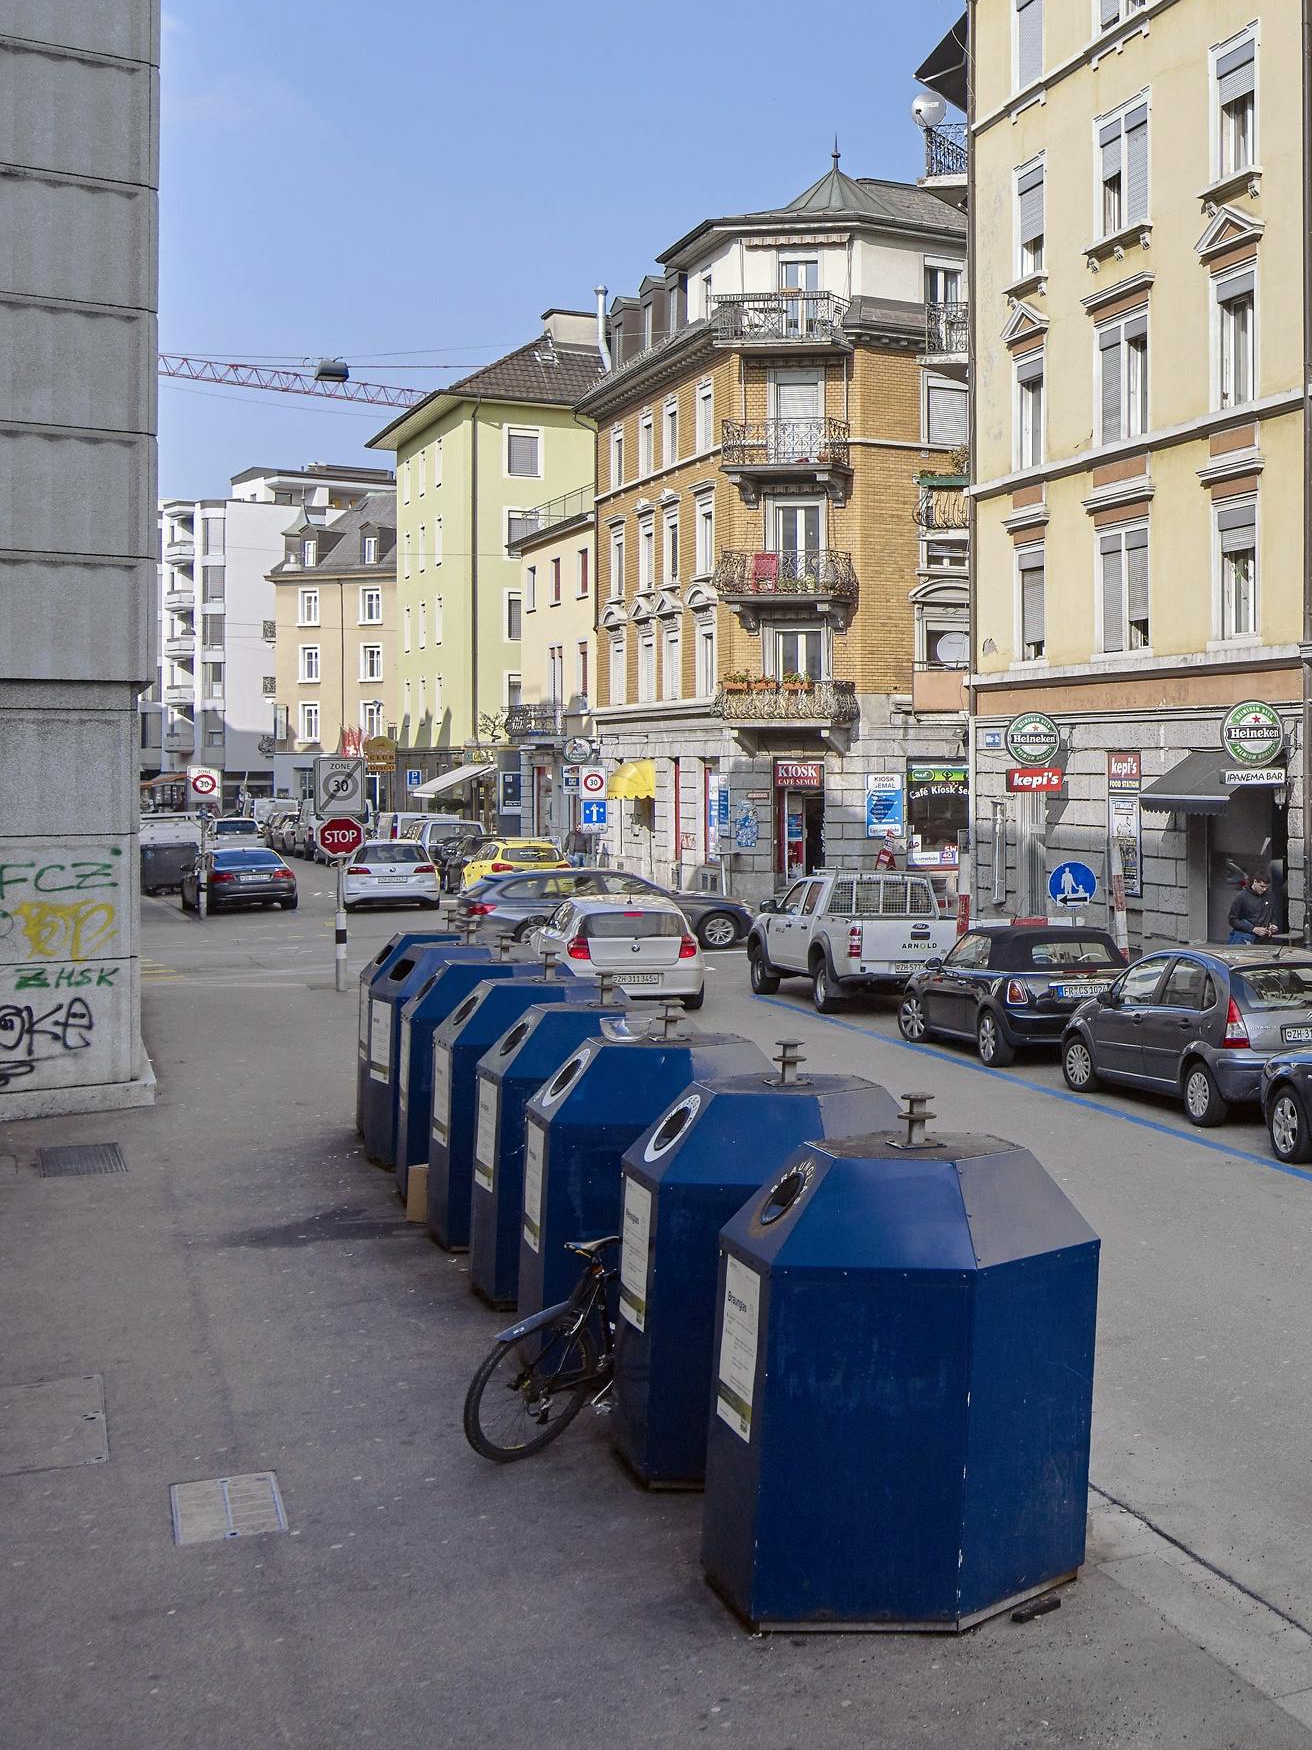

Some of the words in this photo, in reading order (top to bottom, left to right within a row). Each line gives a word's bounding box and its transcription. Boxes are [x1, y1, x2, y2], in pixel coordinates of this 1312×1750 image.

[1013, 734, 1056, 743] Heineken
[1230, 728, 1279, 739] Heineken
[778, 765, 817, 777] KIOSK
[1111, 757, 1137, 778] kepi's
[1013, 771, 1059, 789] kepi's
[1226, 772, 1265, 782] IPANEMA
[1266, 772, 1283, 781] BAR
[200, 780, 209, 788] 30
[333, 780, 348, 792] 30
[1109, 780, 1121, 788] FOOD
[1121, 780, 1139, 789] STATION
[909, 788, 929, 799] Café
[931, 784, 956, 795] Kiosk
[958, 786, 970, 795] Se
[324, 830, 358, 843] STOP
[0, 862, 118, 900] FCZ
